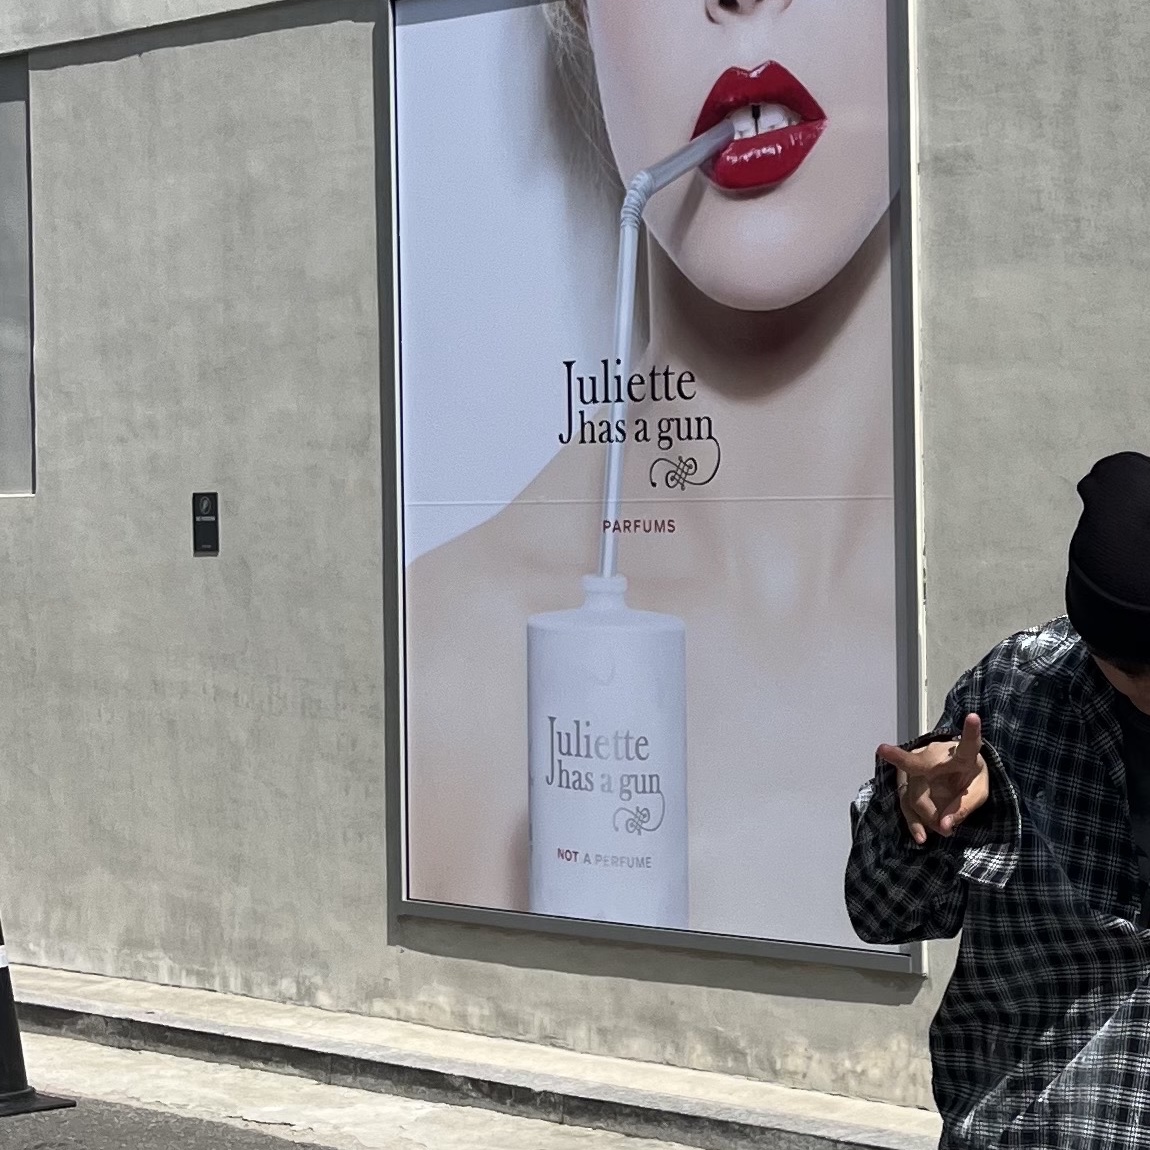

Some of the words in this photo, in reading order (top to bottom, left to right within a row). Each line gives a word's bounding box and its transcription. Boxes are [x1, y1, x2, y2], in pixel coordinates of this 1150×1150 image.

[558, 358, 697, 445] Juliette
[578, 410, 627, 444] has
[634, 417, 650, 443] a
[602, 519, 676, 533] PARFUMS
[545, 716, 650, 786] Juliette
[557, 759, 594, 792] has
[600, 772, 612, 793] a
[557, 848, 579, 863] NOT
[583, 852, 592, 865] A
[594, 854, 652, 868] PERFUME
